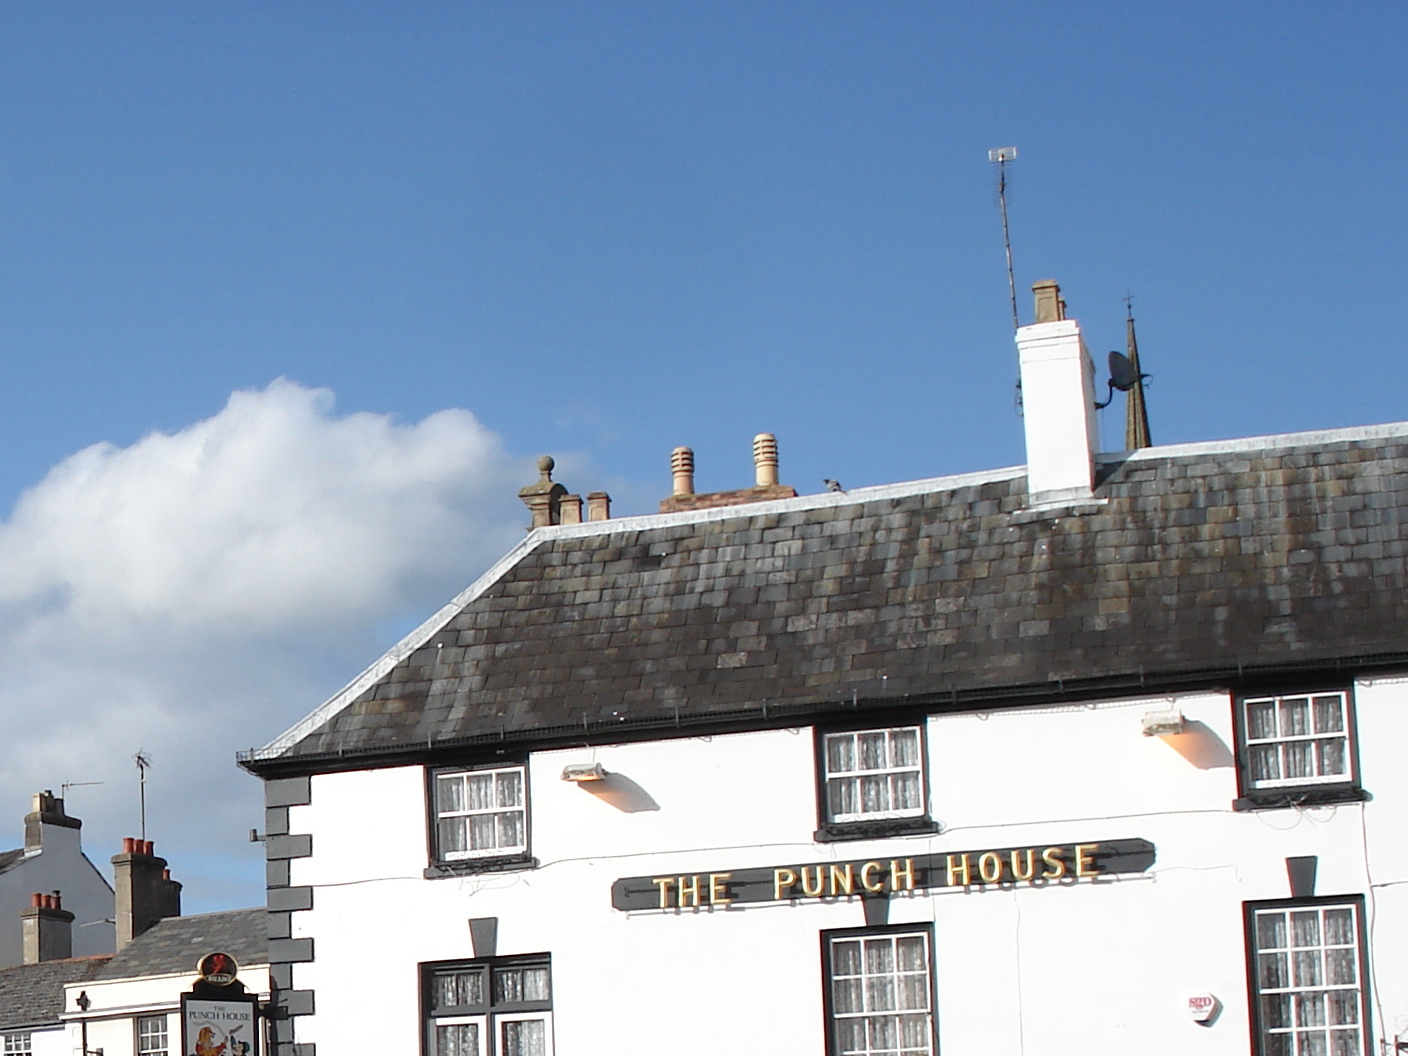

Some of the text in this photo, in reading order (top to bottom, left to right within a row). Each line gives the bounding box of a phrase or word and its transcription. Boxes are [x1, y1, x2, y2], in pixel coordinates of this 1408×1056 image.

[653, 843, 1100, 908] THE PUNCH HOUSE
[189, 1011, 251, 1021] PUNCH HOUSE
